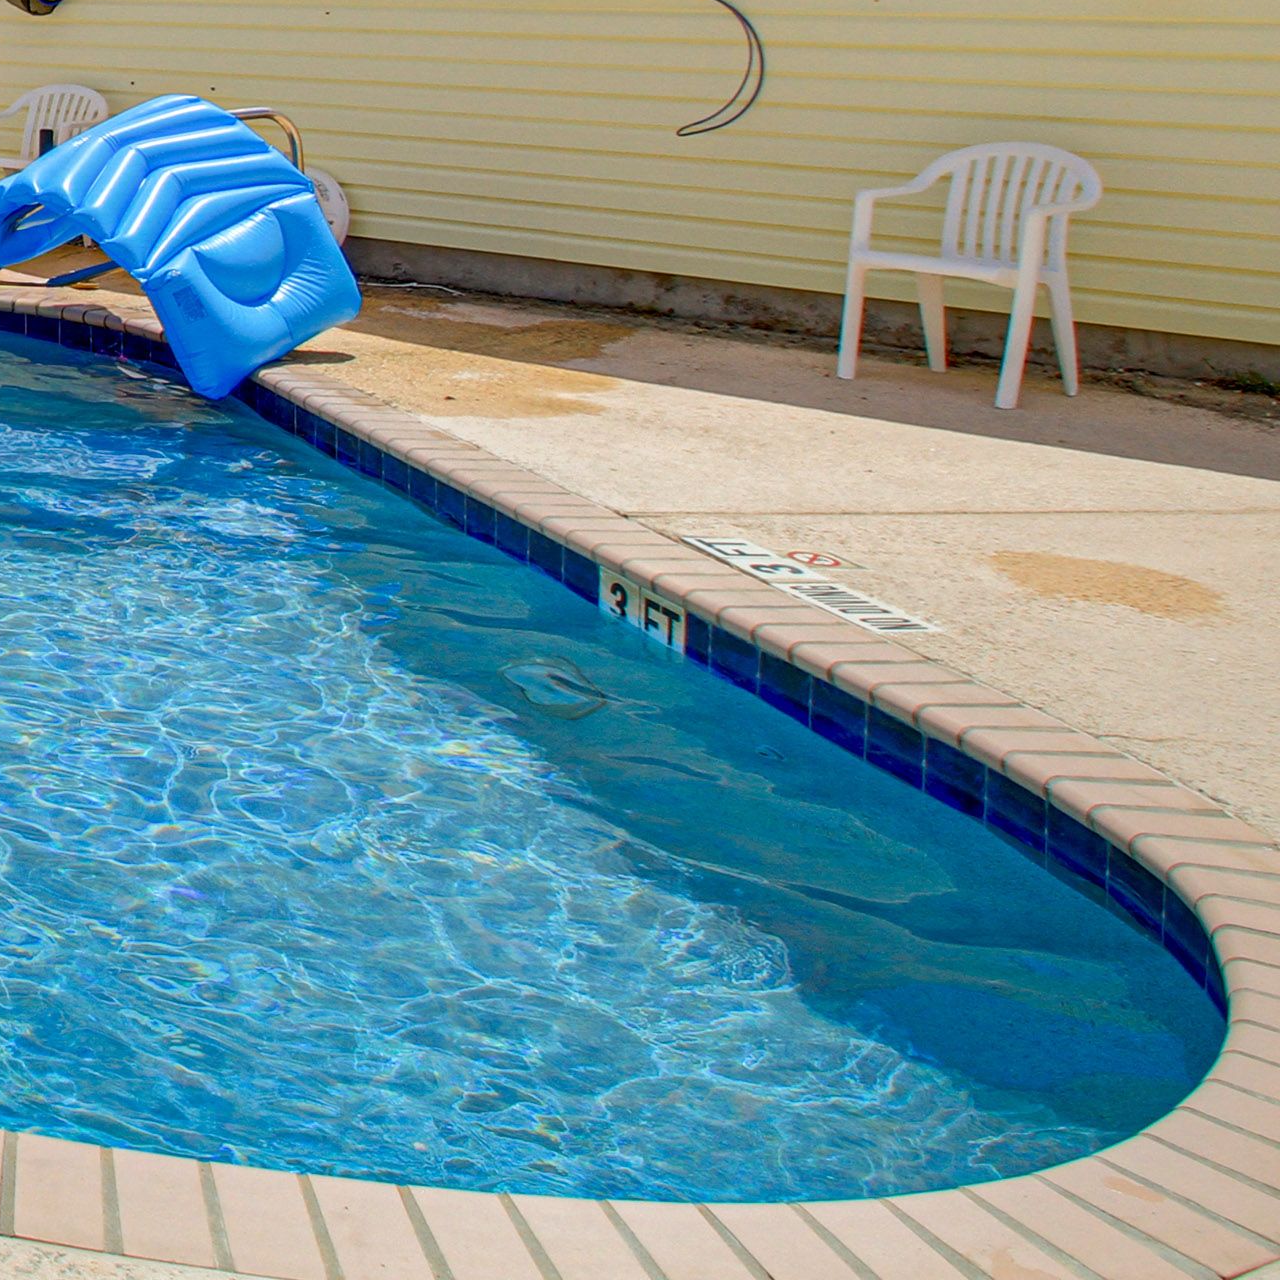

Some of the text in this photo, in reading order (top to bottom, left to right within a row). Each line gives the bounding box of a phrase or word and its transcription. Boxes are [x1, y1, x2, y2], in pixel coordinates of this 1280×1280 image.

[693, 538, 804, 575] 3 FT
[609, 582, 681, 647] 3 FT
[789, 585, 929, 630] NO DIVING
